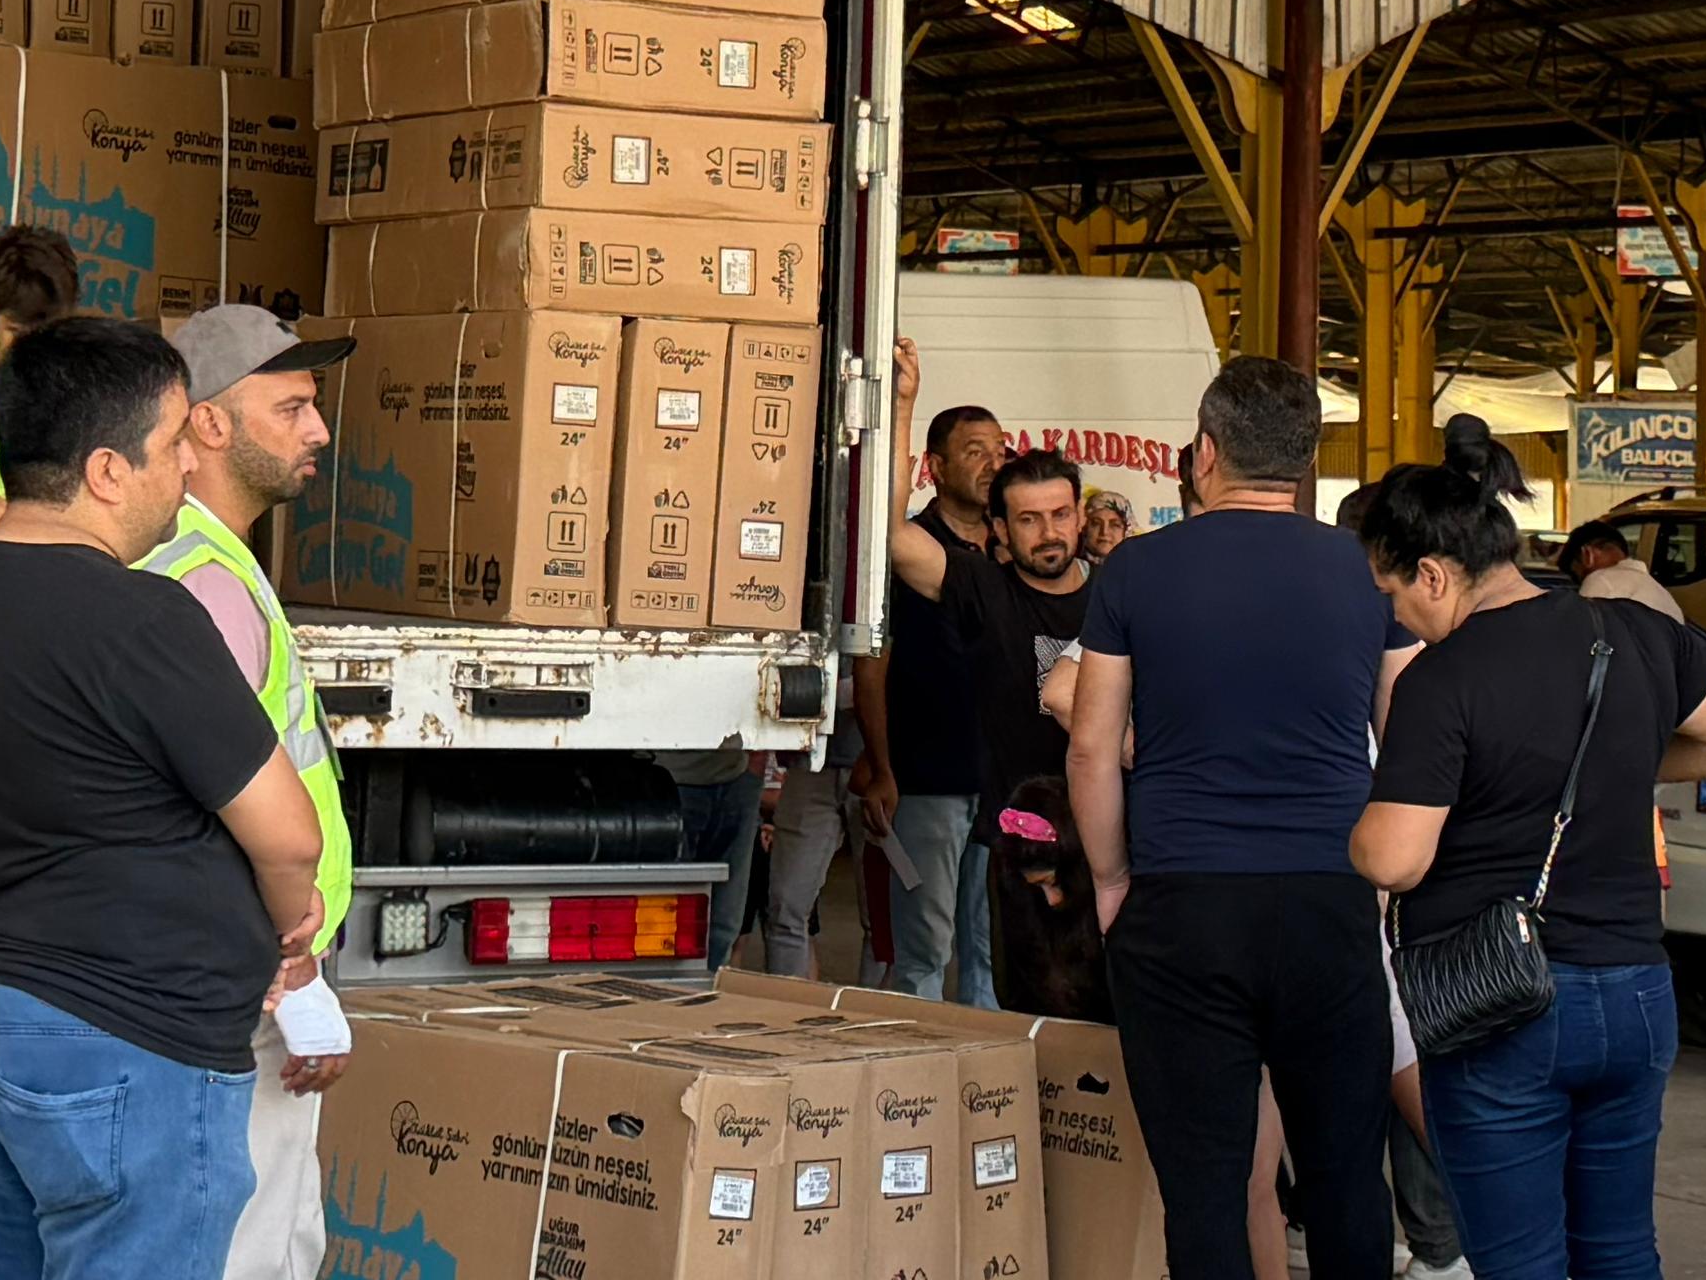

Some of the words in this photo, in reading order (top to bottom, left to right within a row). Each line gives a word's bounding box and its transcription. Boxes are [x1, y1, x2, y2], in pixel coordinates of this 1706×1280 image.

[229, 117, 262, 135] izler
[91, 124, 146, 162] Konya
[1043, 429, 1181, 483] KARDEŞL
[1621, 448, 1697, 468] BALIKÇIL
[1058, 1111, 1116, 1138] neşesi,
[397, 1121, 459, 1175] Konya
[481, 1159, 569, 1196] yarınımzın
[575, 1172, 659, 1211] ümidisiniz.
[595, 1155, 652, 1185] neşesi,
[549, 1217, 579, 1237] UĞUR
